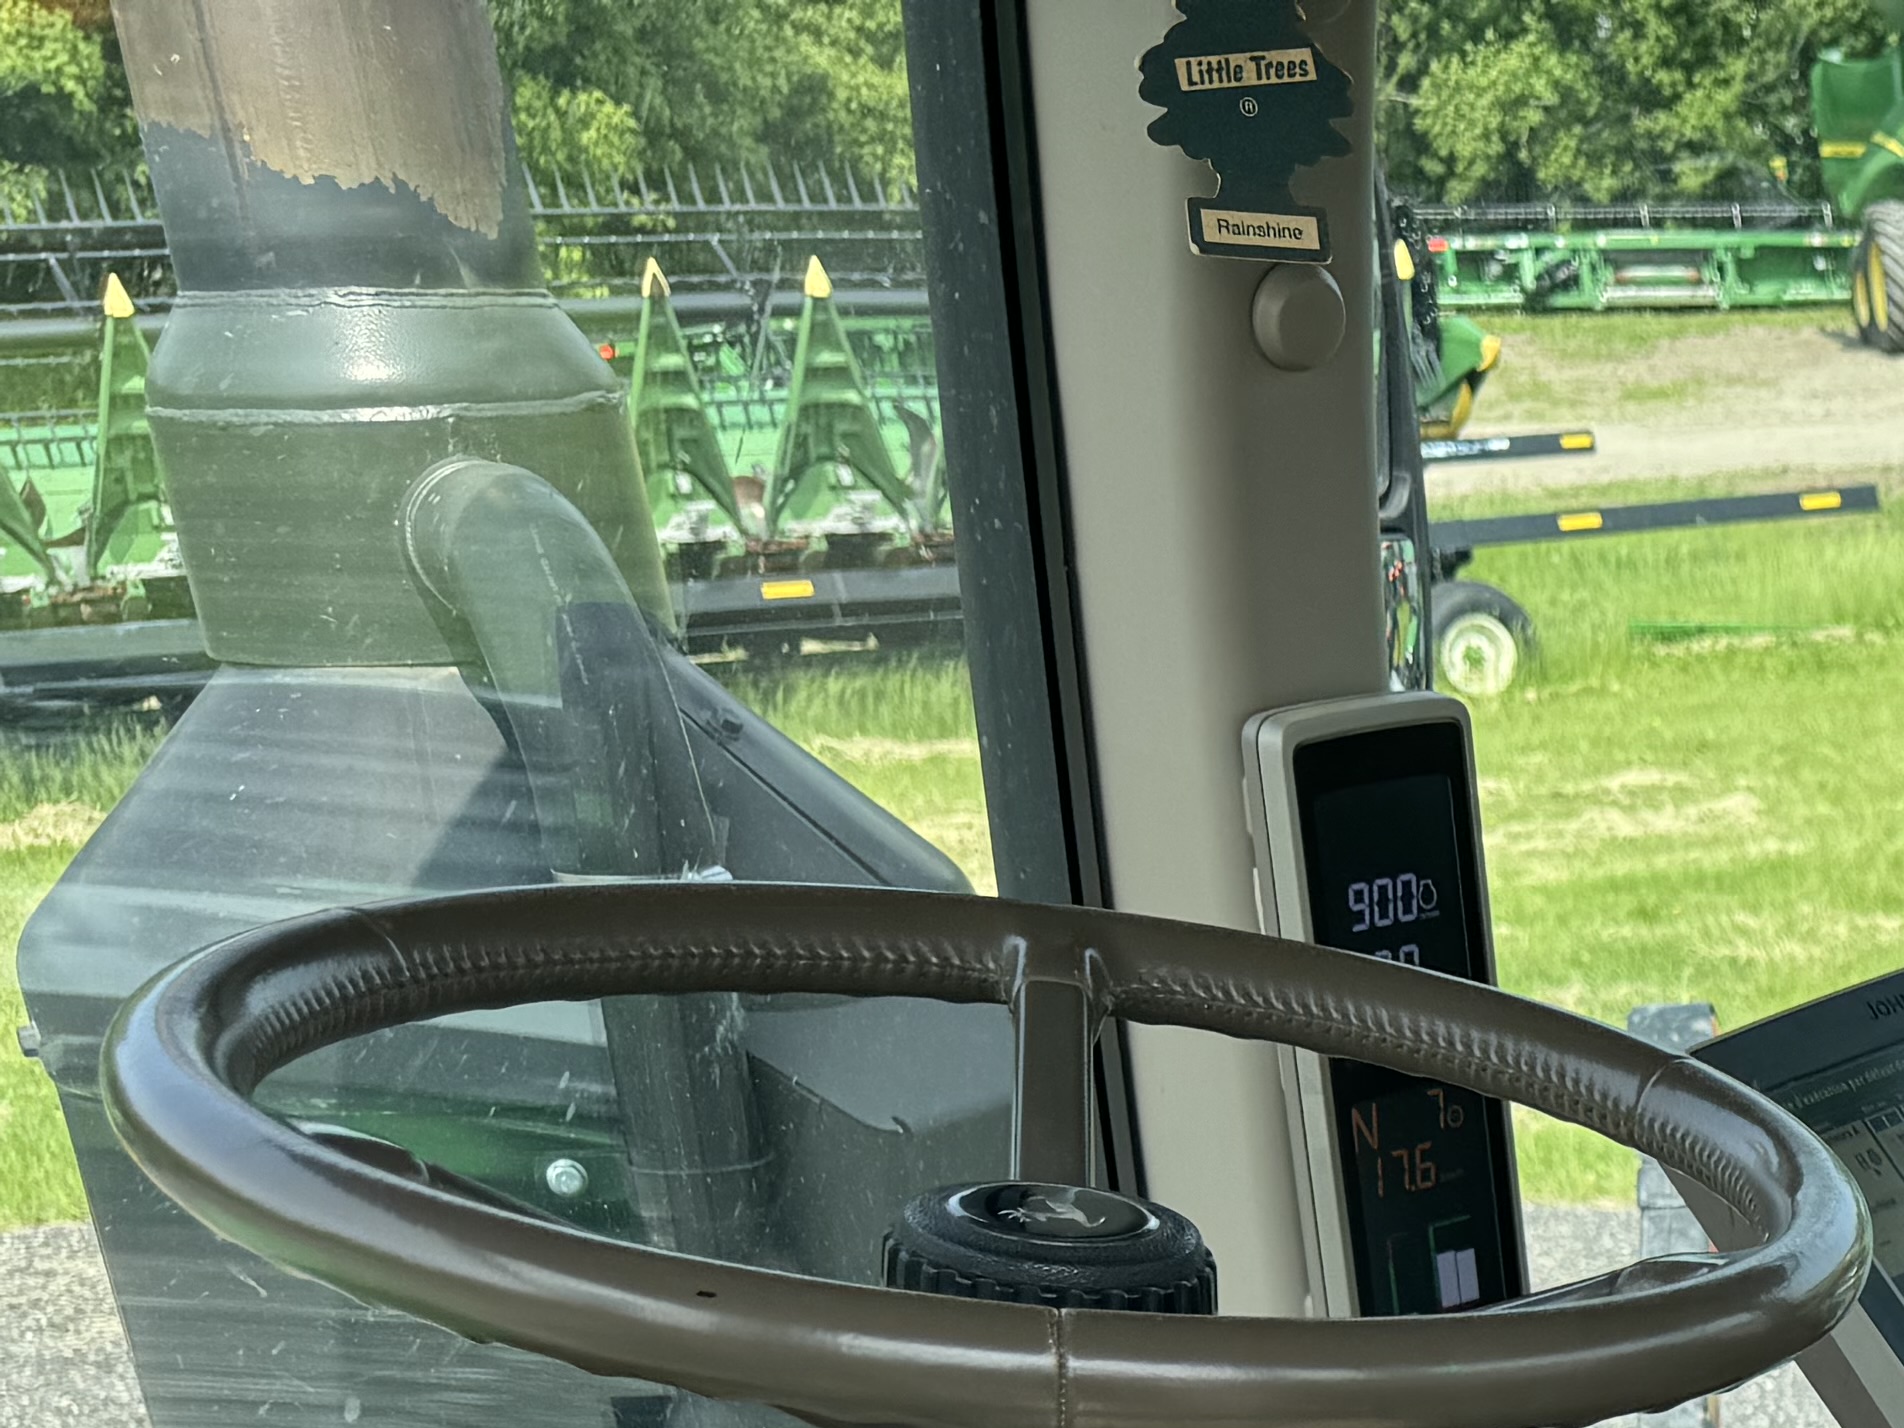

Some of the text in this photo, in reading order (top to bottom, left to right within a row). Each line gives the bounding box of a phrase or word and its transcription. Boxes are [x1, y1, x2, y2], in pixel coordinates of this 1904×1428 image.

[1185, 55, 1310, 87] Little Trees
[1216, 217, 1304, 241] Rainshine
[1348, 872, 1418, 932] 900
[1351, 1101, 1379, 1154] N
